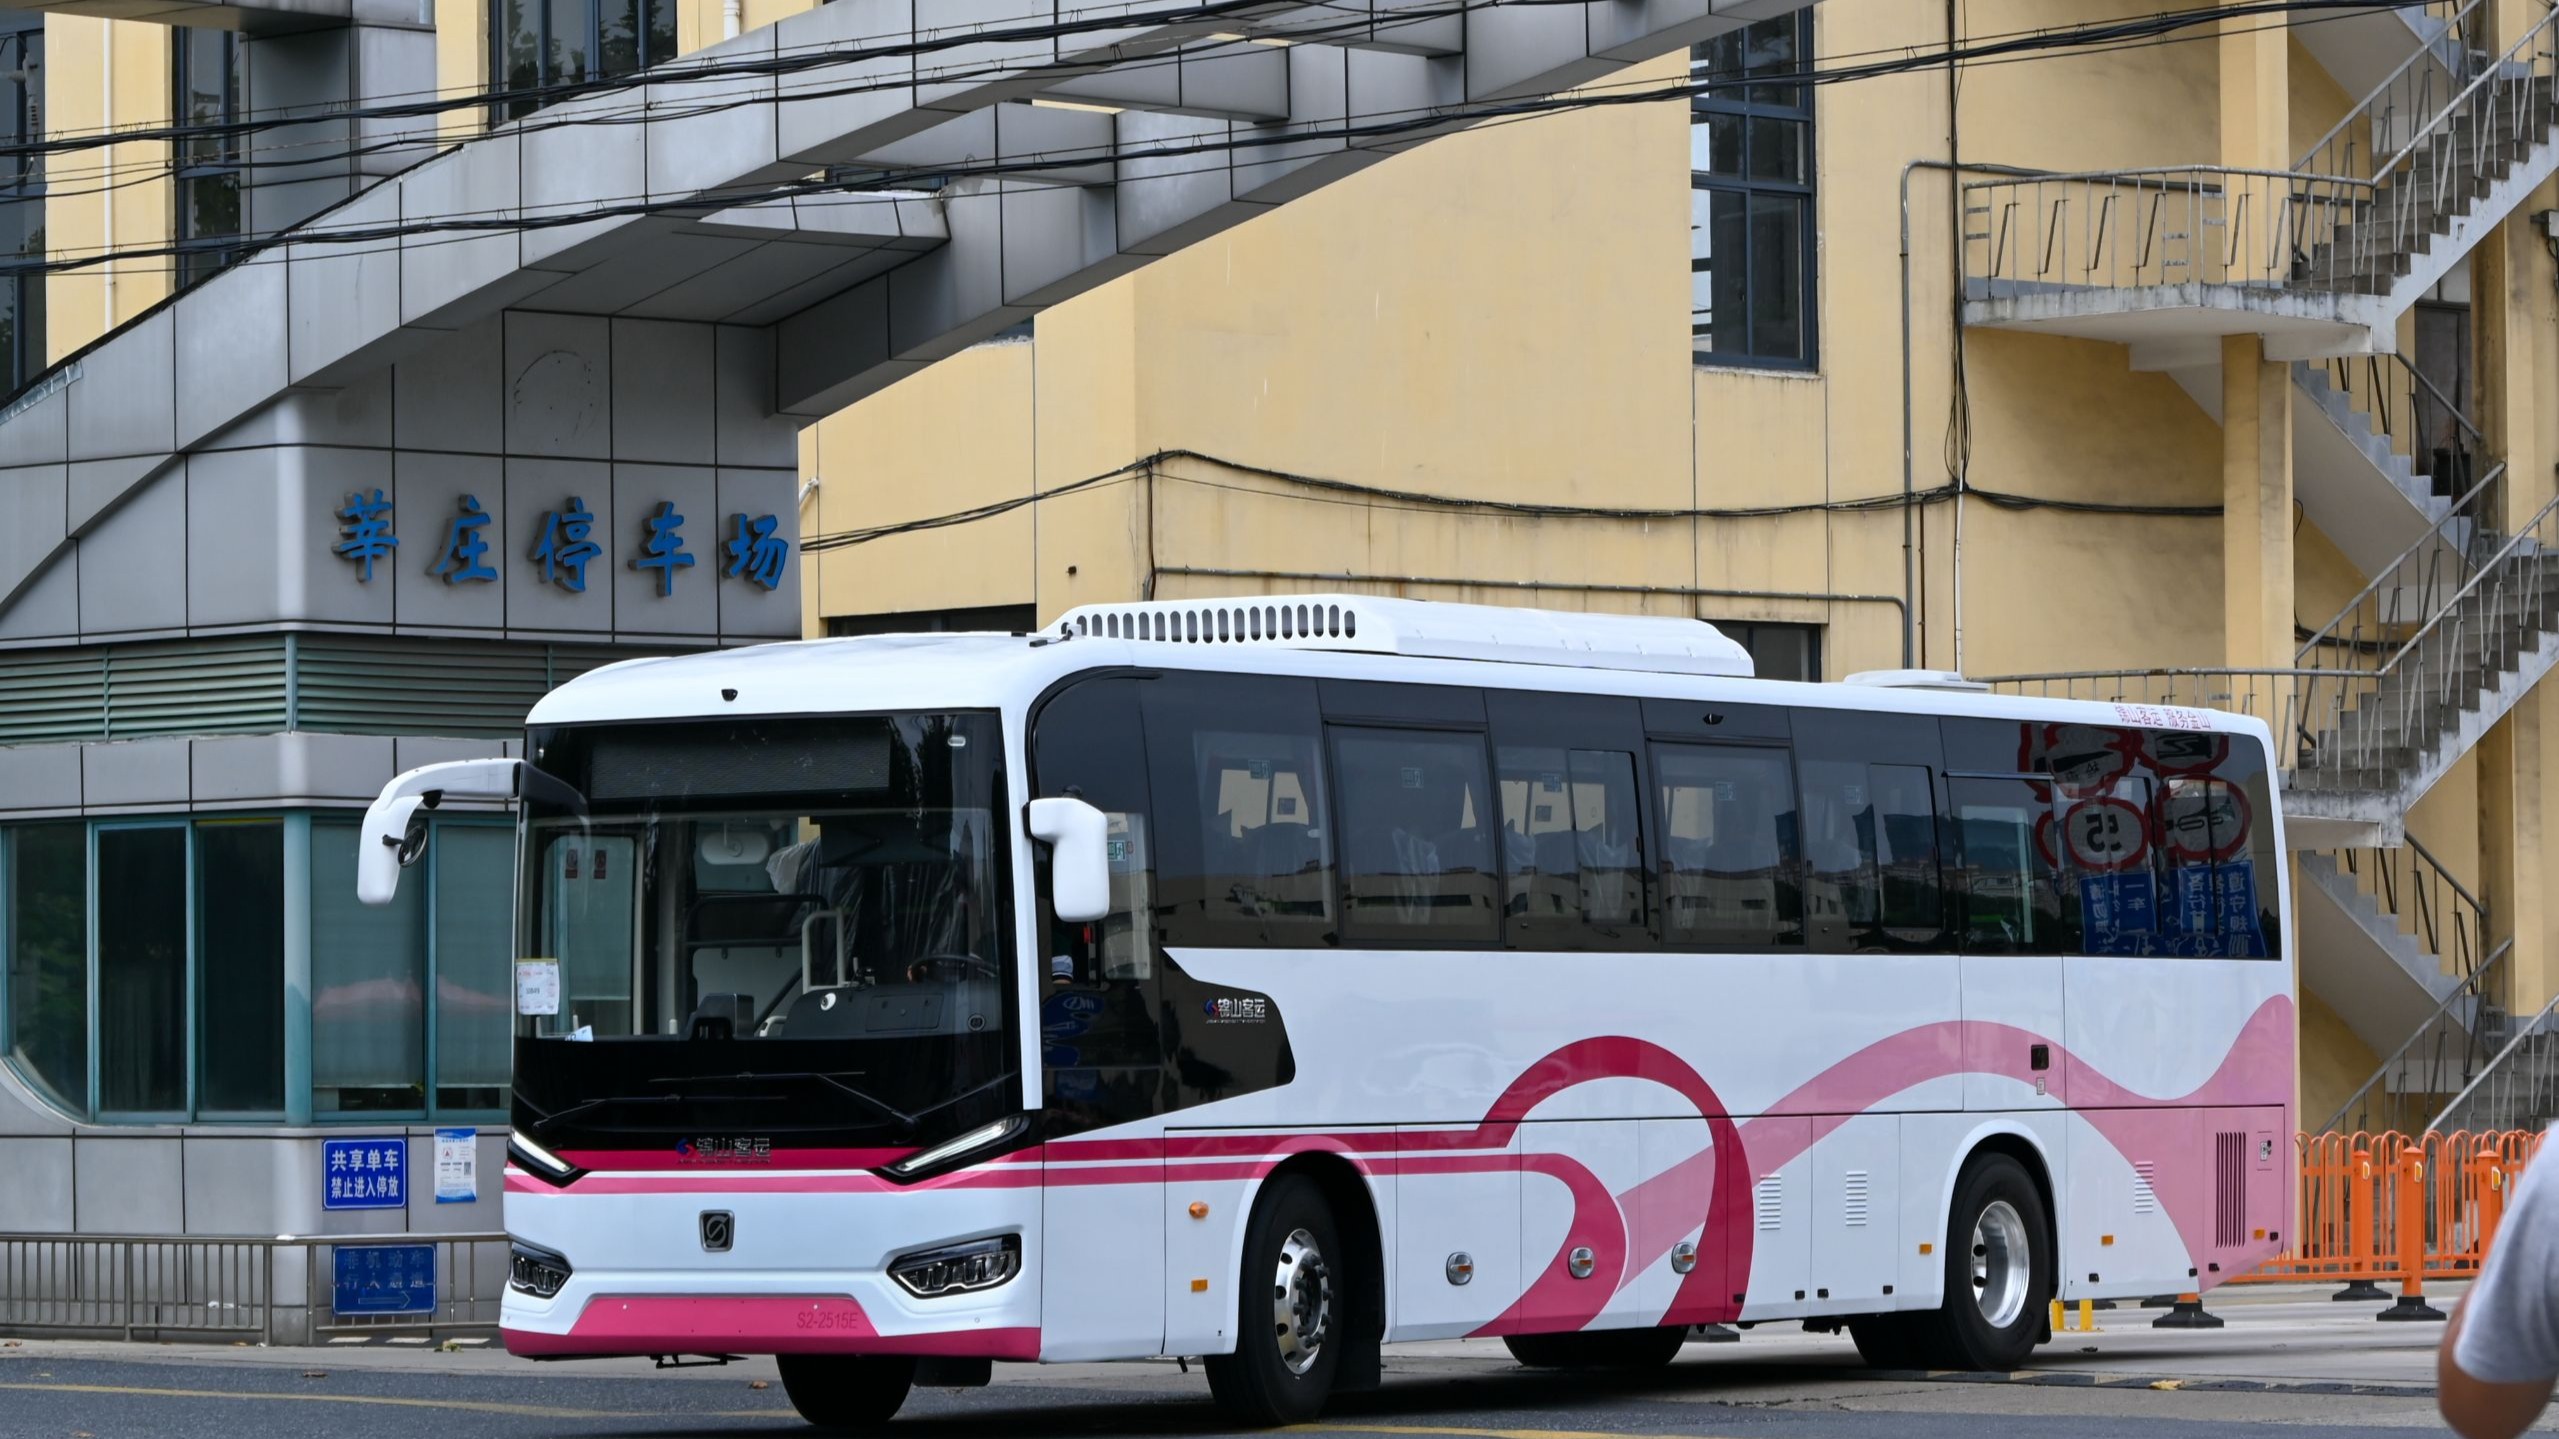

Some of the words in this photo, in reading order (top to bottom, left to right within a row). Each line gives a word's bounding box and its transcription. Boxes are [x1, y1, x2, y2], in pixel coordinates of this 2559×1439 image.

[332, 488, 789, 598] 莘庄停车场
[331, 1148, 399, 1172] 共享单车
[331, 1175, 399, 1199] 禁止进入停放
[796, 1311, 858, 1329] S2-2515E
